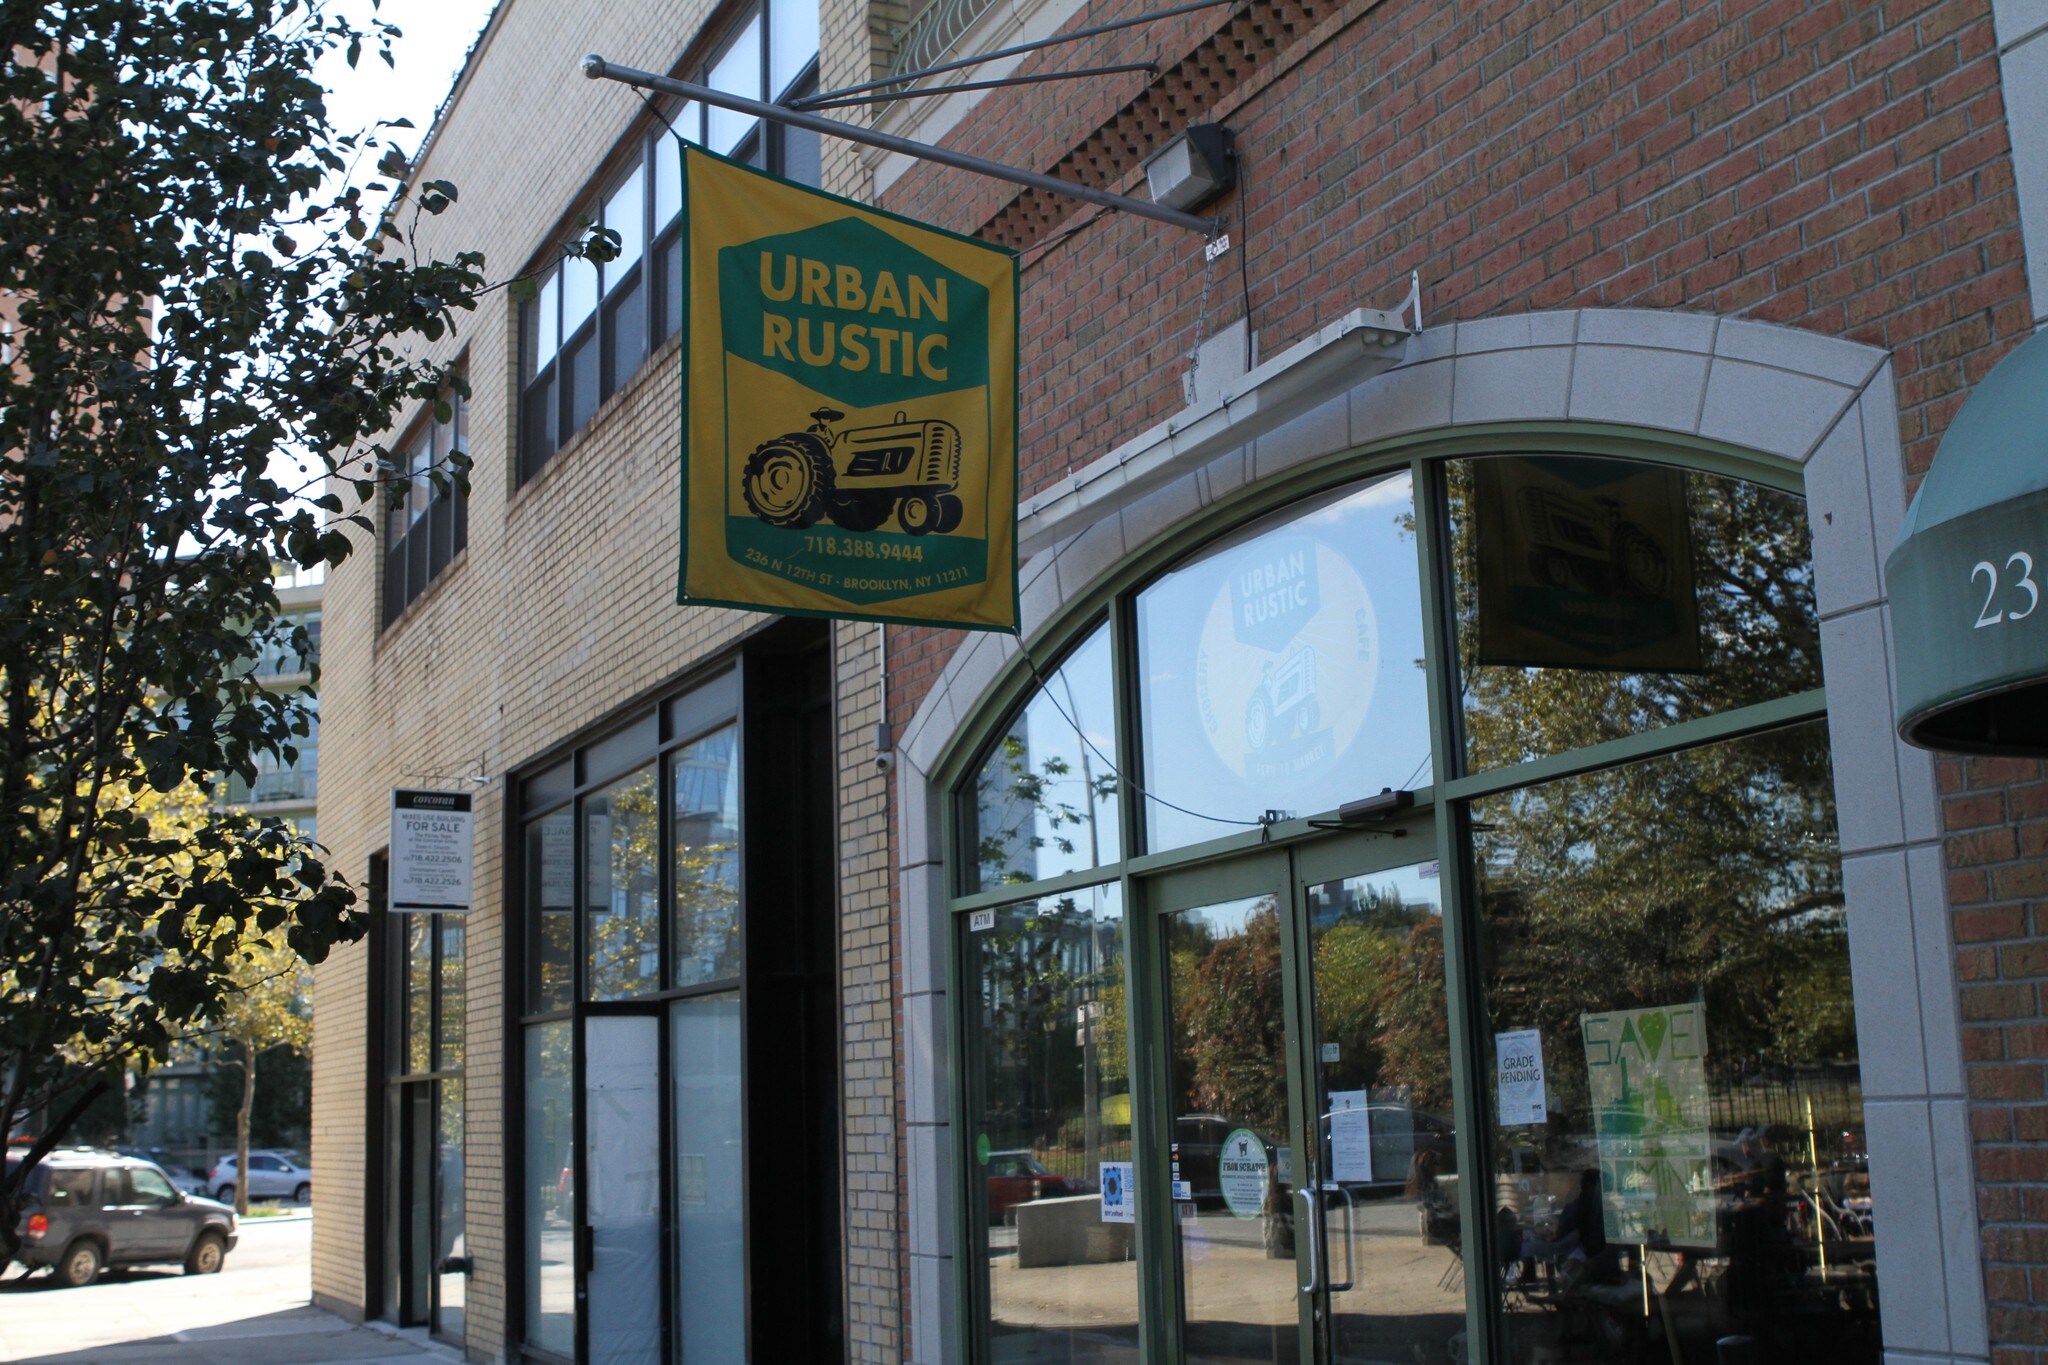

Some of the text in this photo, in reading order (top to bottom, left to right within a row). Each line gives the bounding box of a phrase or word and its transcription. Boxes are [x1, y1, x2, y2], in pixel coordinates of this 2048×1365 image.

[760, 250, 948, 323] URBAN
[762, 310, 948, 382] RUSTIC
[803, 535, 924, 563] 718.388.9444
[745, 547, 769, 567] 236
[771, 558, 782, 572] N
[786, 563, 817, 583] 12TH
[819, 572, 833, 586] ST
[843, 577, 912, 591] BROOKLYN,
[915, 575, 932, 589] NY
[936, 566, 969, 585] 11211
[1241, 550, 1304, 598] URBAN
[1243, 580, 1308, 627] RUSTIC
[1970, 551, 2048, 629] 23
[413, 795, 455, 805] corcoran
[406, 821, 460, 833] FOR SALE
[436, 815, 466, 823] BUILDING
[974, 913, 990, 928] ATM
[1500, 1069, 1541, 1084] PENDING
[1503, 1055, 1534, 1070] GRADE
